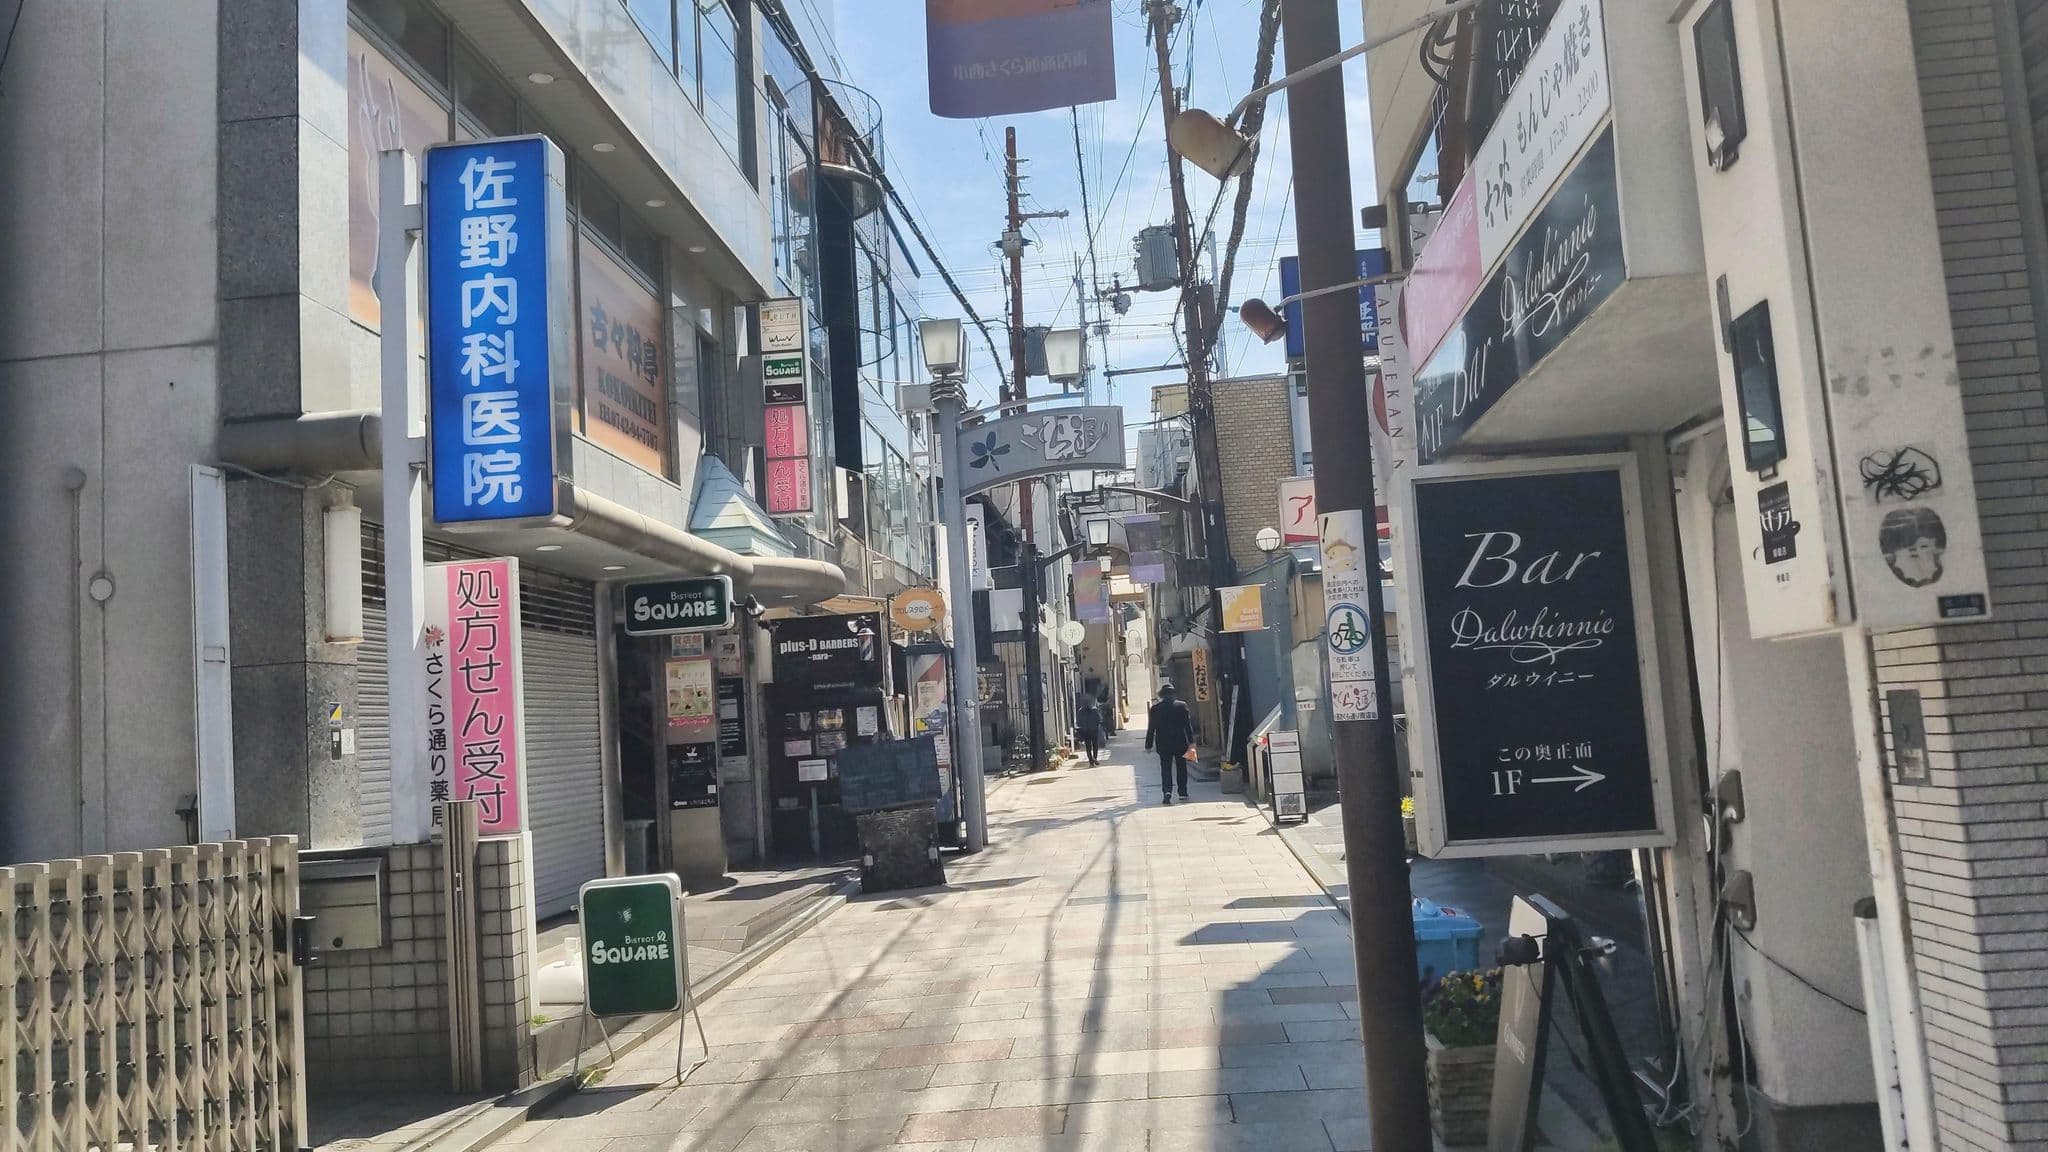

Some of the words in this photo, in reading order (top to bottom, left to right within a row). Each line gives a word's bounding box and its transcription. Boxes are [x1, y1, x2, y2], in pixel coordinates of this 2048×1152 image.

[1499, 192, 1598, 343] Dalwhinnie
[459, 156, 523, 506] 佐野内科医院
[765, 365, 801, 376] SQUARE
[771, 409, 792, 511] 処方せん受付
[1455, 531, 1601, 589] Bar
[633, 597, 717, 621] SQUARE
[1450, 605, 1615, 649] Dalwhinnie
[780, 639, 817, 654] plus-D
[457, 569, 507, 825] 処方せん受付
[1485, 669, 1594, 690] ダルウイニー
[425, 652, 449, 828] さくら通り薬局
[1498, 741, 1593, 763] この奥正面
[1490, 769, 1524, 796] 1F
[591, 939, 670, 965] SQUARE
